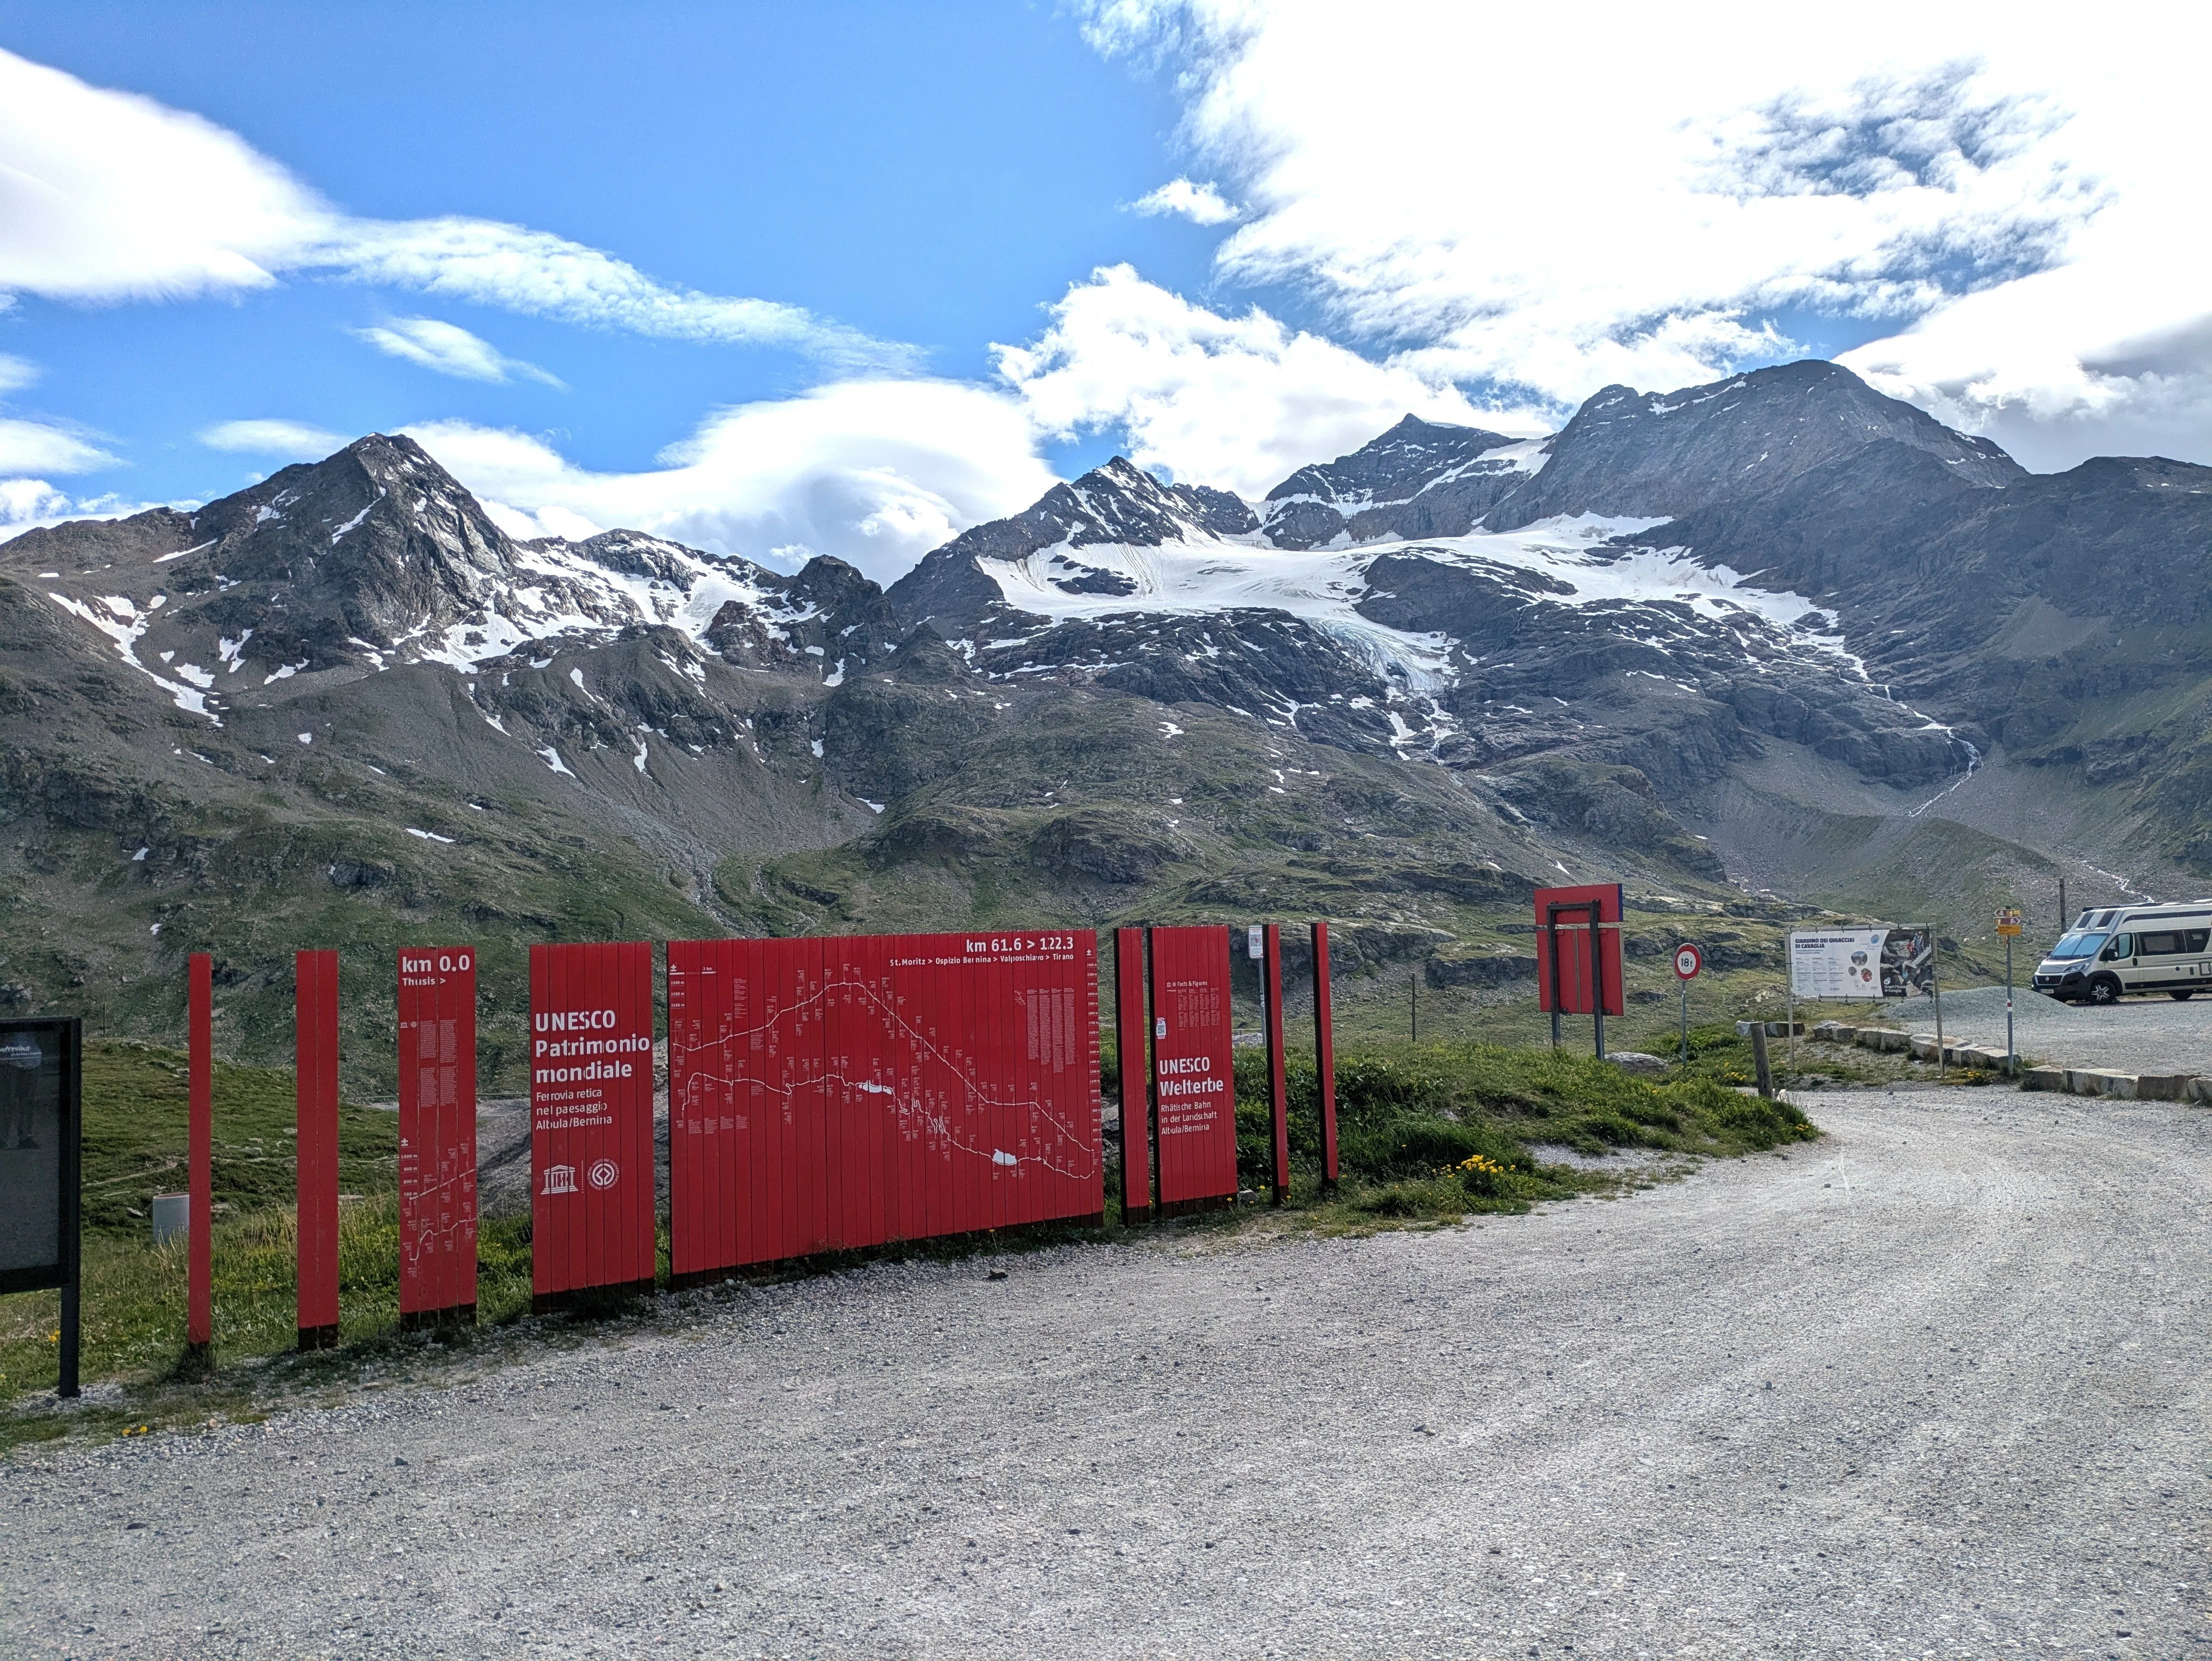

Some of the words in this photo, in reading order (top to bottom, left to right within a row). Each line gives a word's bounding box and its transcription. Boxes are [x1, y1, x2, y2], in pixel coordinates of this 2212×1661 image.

[966, 939, 986, 952] km
[991, 938, 1022, 952] 61.6
[1040, 937, 1073, 950] 122.3
[403, 957, 431, 973] km
[440, 955, 470, 972] 0.0
[935, 957, 961, 965] Ospizio
[1000, 954, 1044, 963] Valposchiavo
[402, 976, 435, 986] Thusis
[536, 1010, 616, 1032] UNESCO
[536, 1033, 650, 1057] Patrimonio
[536, 1061, 632, 1084] mondiale
[1160, 1057, 1210, 1075] UNESCO
[1160, 1077, 1224, 1096] Welterbe
[536, 1090, 574, 1101] Ferrovia
[577, 1088, 602, 1098] retica
[537, 1105, 553, 1116] nel
[556, 1101, 607, 1117] paesaggio
[1161, 1102, 1192, 1112] Rhätische
[1194, 1101, 1211, 1109] Bahn
[536, 1116, 612, 1130] Albula/Bernina
[1161, 1116, 1168, 1124] in
[1183, 1111, 1217, 1122] Landschaft
[1161, 1124, 1209, 1135] Albula/Bernina
[545, 1172, 574, 1188] UNESCO
